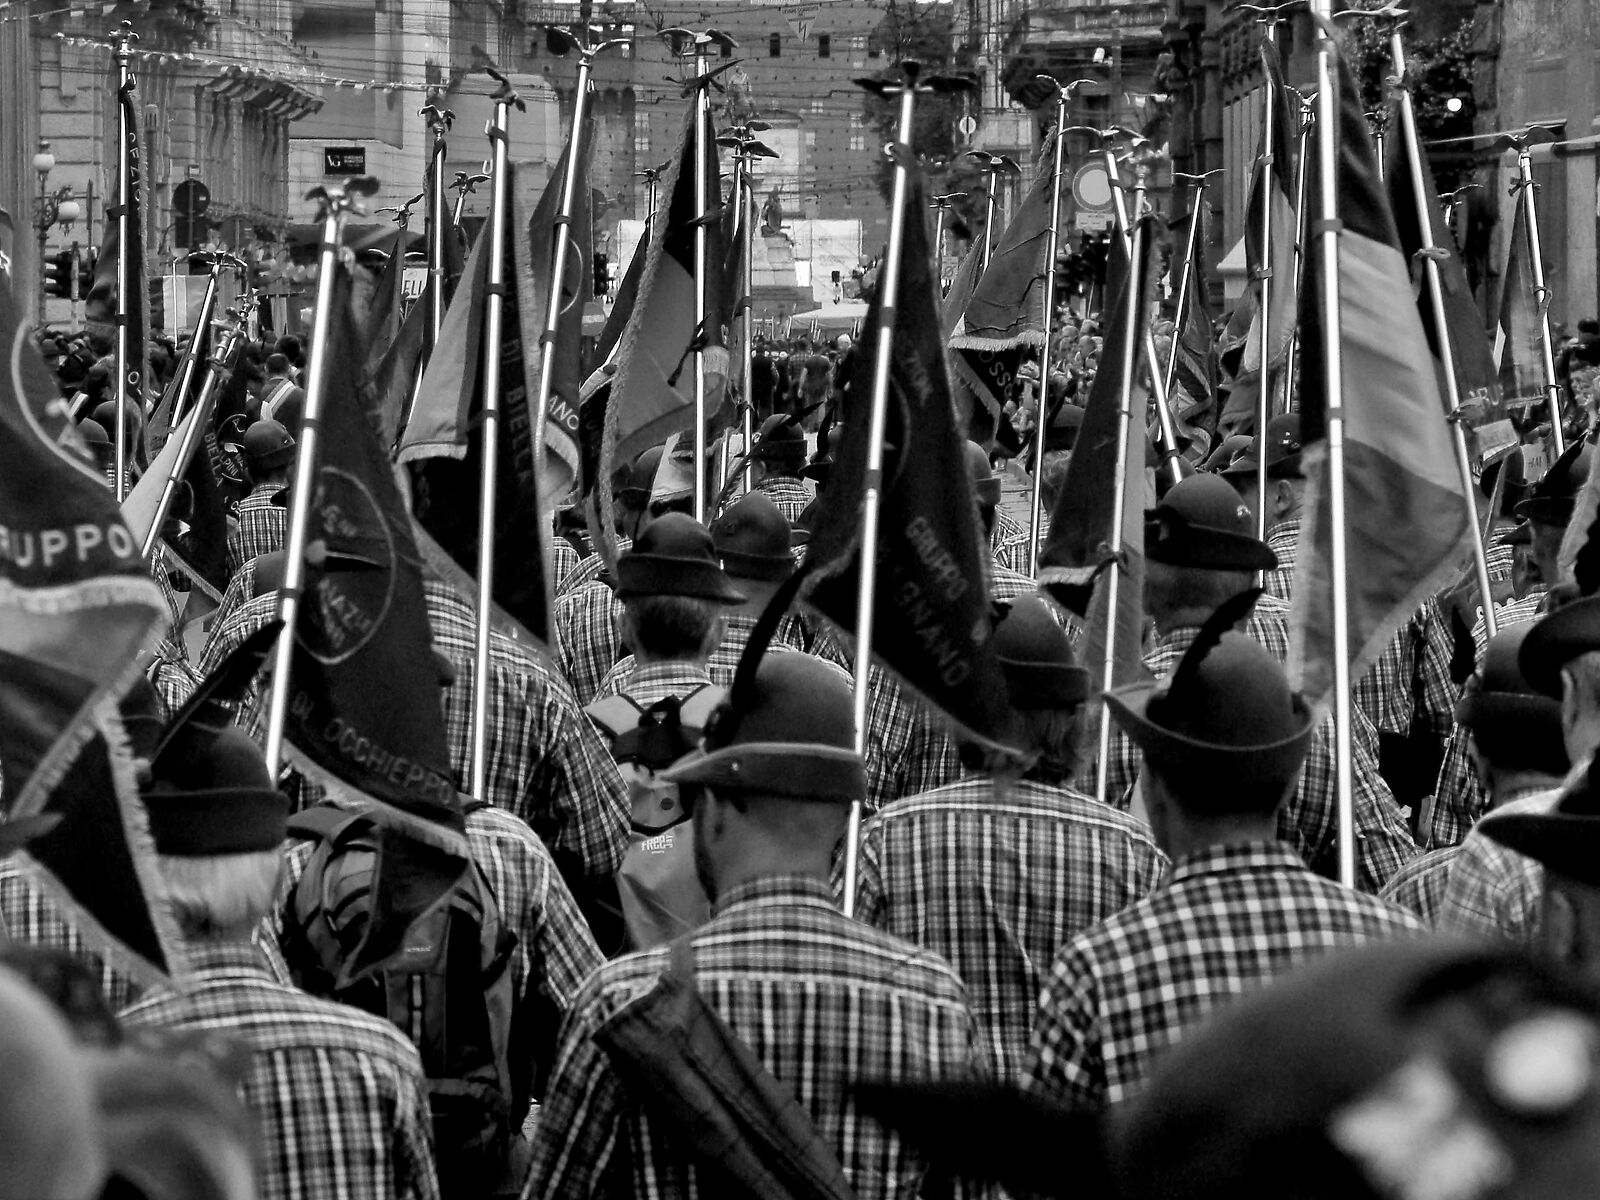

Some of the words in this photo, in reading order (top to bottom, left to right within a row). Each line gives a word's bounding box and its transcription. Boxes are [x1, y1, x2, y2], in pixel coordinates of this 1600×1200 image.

[548, 395, 580, 430] ANO
[889, 568, 970, 687] GNANO
[324, 717, 452, 805] OCCHIEPPO
